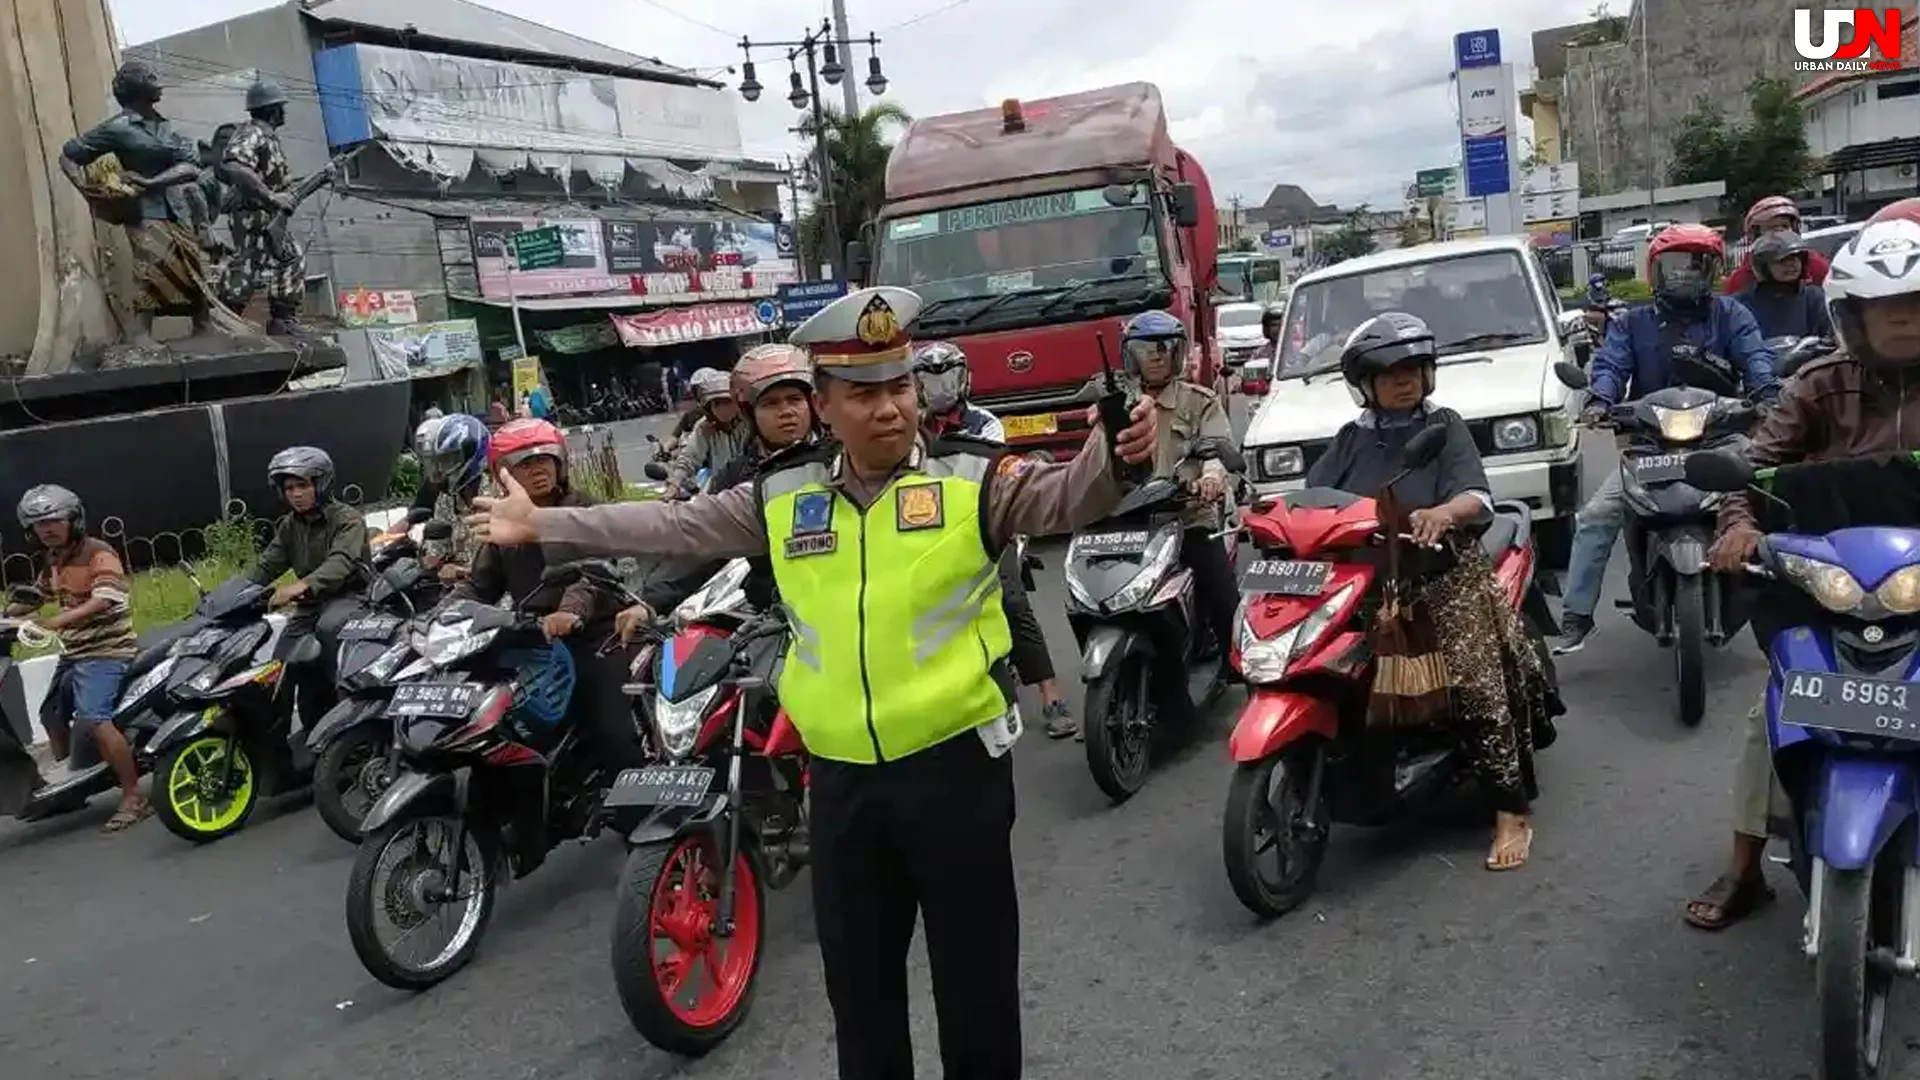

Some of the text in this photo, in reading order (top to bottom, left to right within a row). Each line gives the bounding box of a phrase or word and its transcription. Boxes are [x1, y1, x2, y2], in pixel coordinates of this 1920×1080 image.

[1470, 88, 1496, 99] ATM
[1248, 561, 1267, 574] AD
[1268, 561, 1301, 577] 6801
[1789, 675, 1908, 710] AD 6963
[1875, 715, 1904, 730] 03
